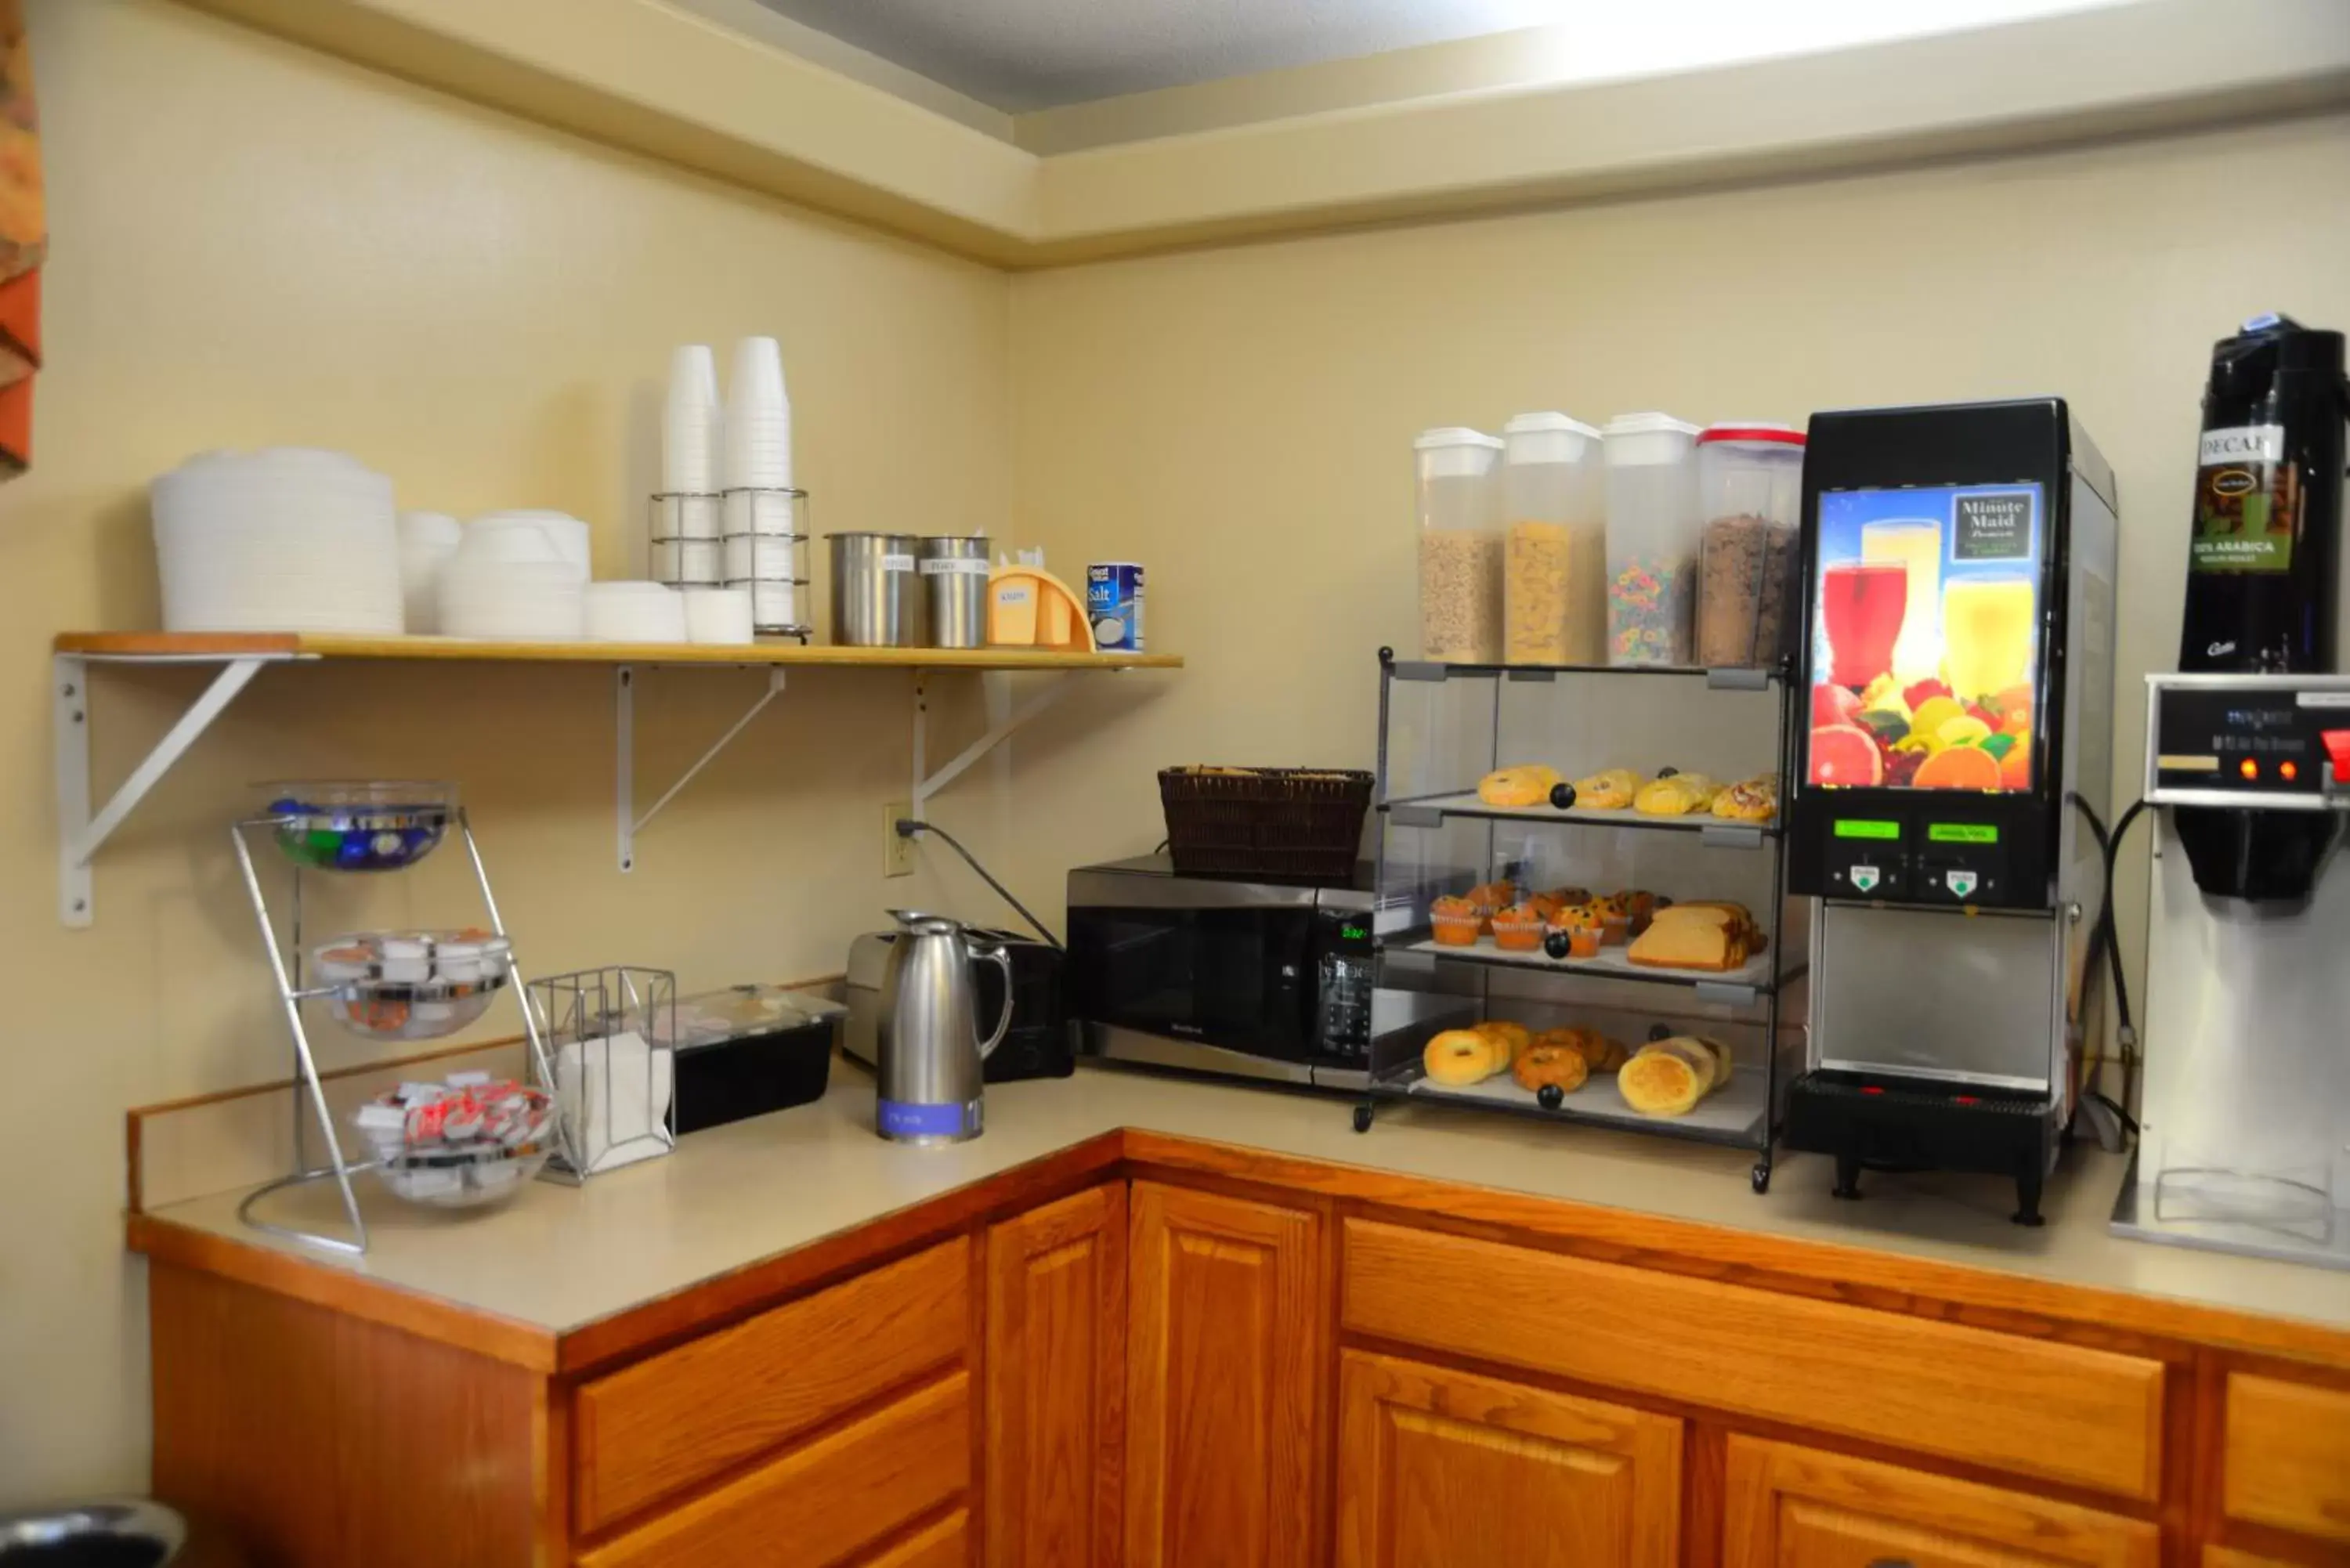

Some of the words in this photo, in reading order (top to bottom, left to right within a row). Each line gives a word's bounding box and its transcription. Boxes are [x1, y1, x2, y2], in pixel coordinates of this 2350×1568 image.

[2202, 435, 2267, 454] DECAF
[1962, 501, 2024, 514] Minute
[1971, 515, 2016, 529] Maid
[2215, 540, 2275, 553] ARABICA
[1089, 585, 1110, 602] Salt
